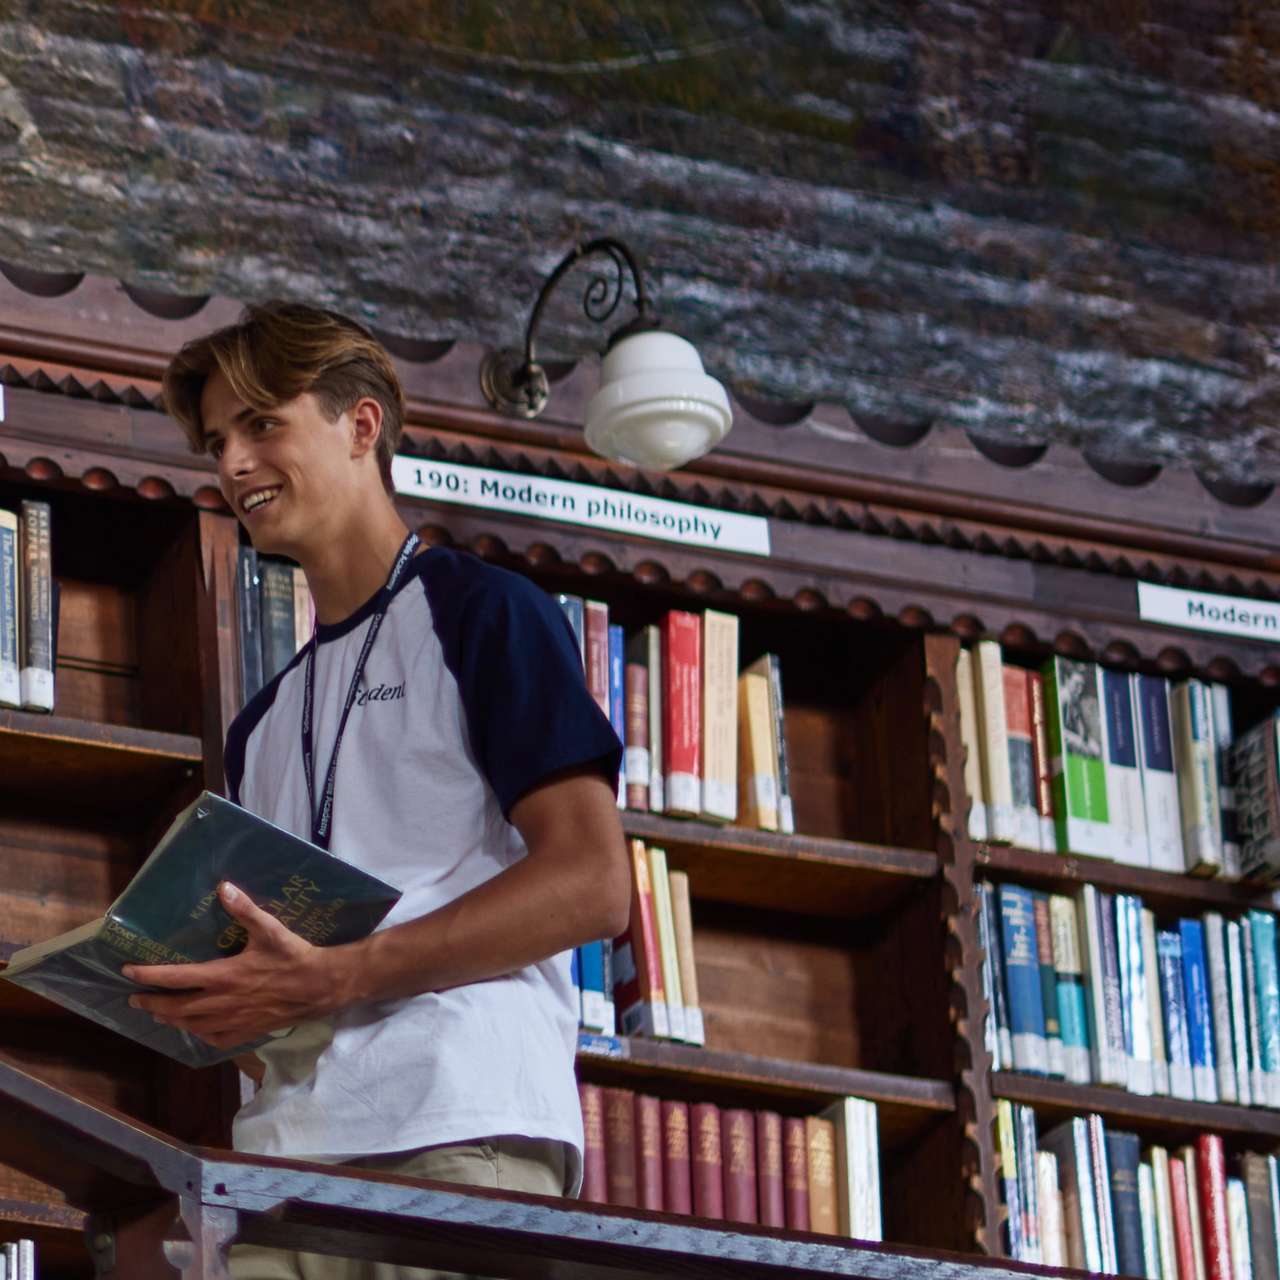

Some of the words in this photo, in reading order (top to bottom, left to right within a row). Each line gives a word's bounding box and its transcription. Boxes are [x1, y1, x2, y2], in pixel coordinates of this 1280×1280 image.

[413, 467, 470, 494] 190:
[480, 479, 577, 511] Modern
[586, 496, 723, 541] philosophy
[1186, 599, 1278, 629] Modern
